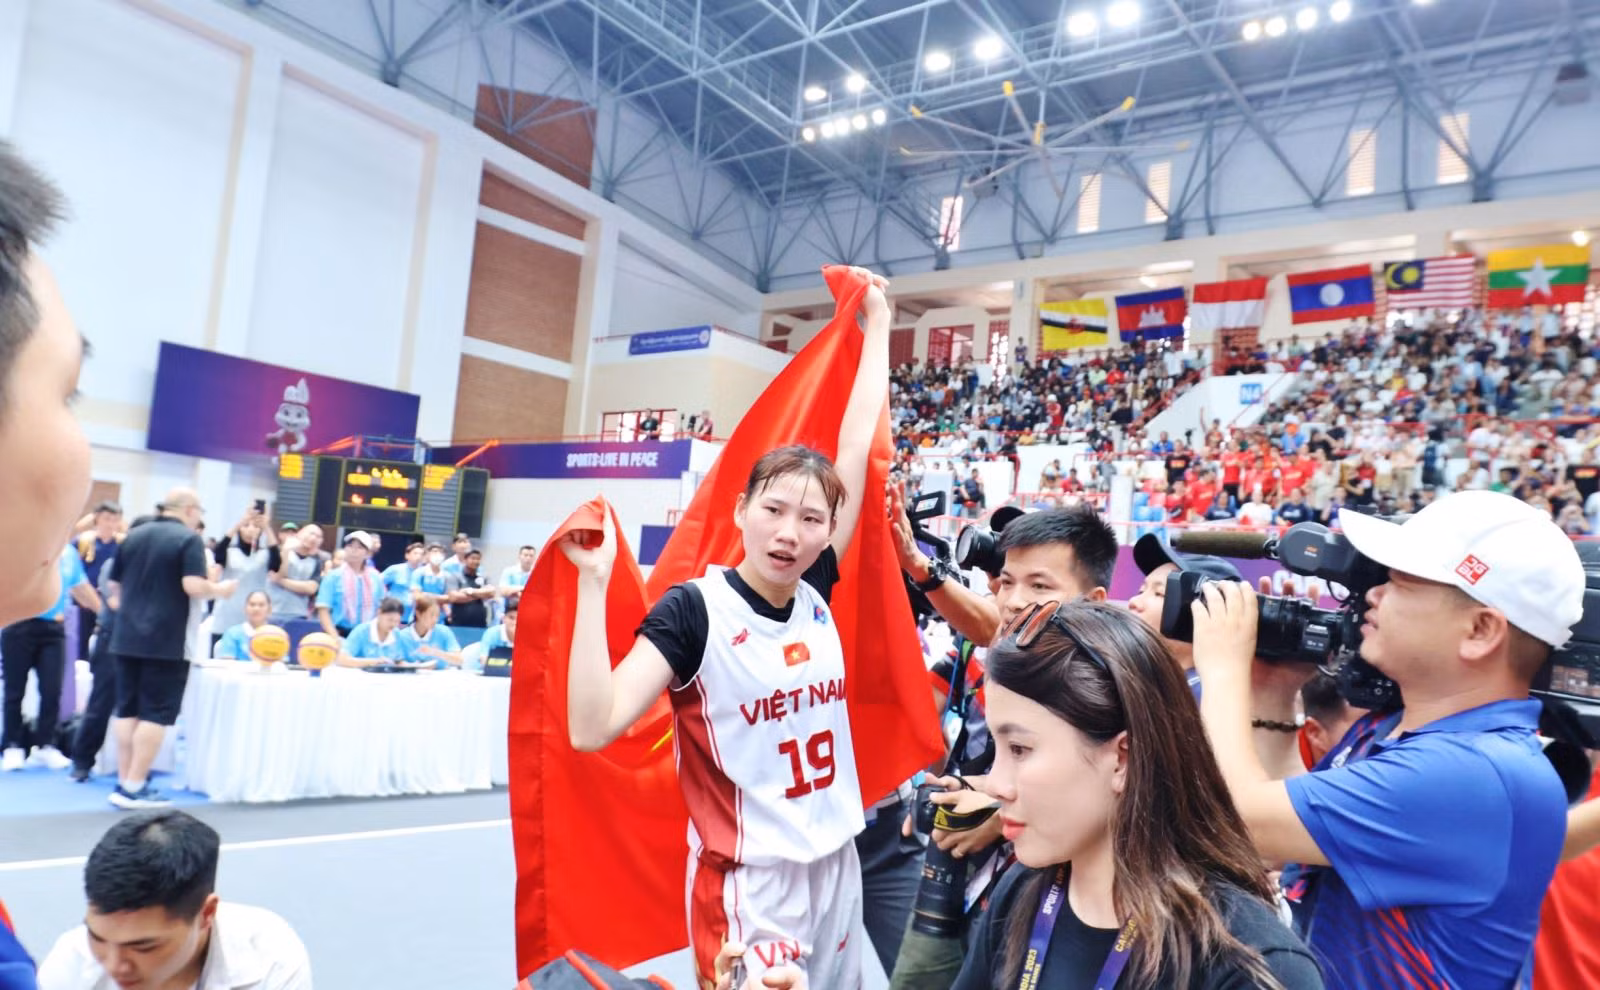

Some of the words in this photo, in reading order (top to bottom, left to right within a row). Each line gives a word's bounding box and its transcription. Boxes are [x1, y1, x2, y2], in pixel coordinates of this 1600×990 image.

[630, 451, 658, 467] PEACE
[740, 688, 803, 726] VIỆT
[778, 729, 836, 800] 19
